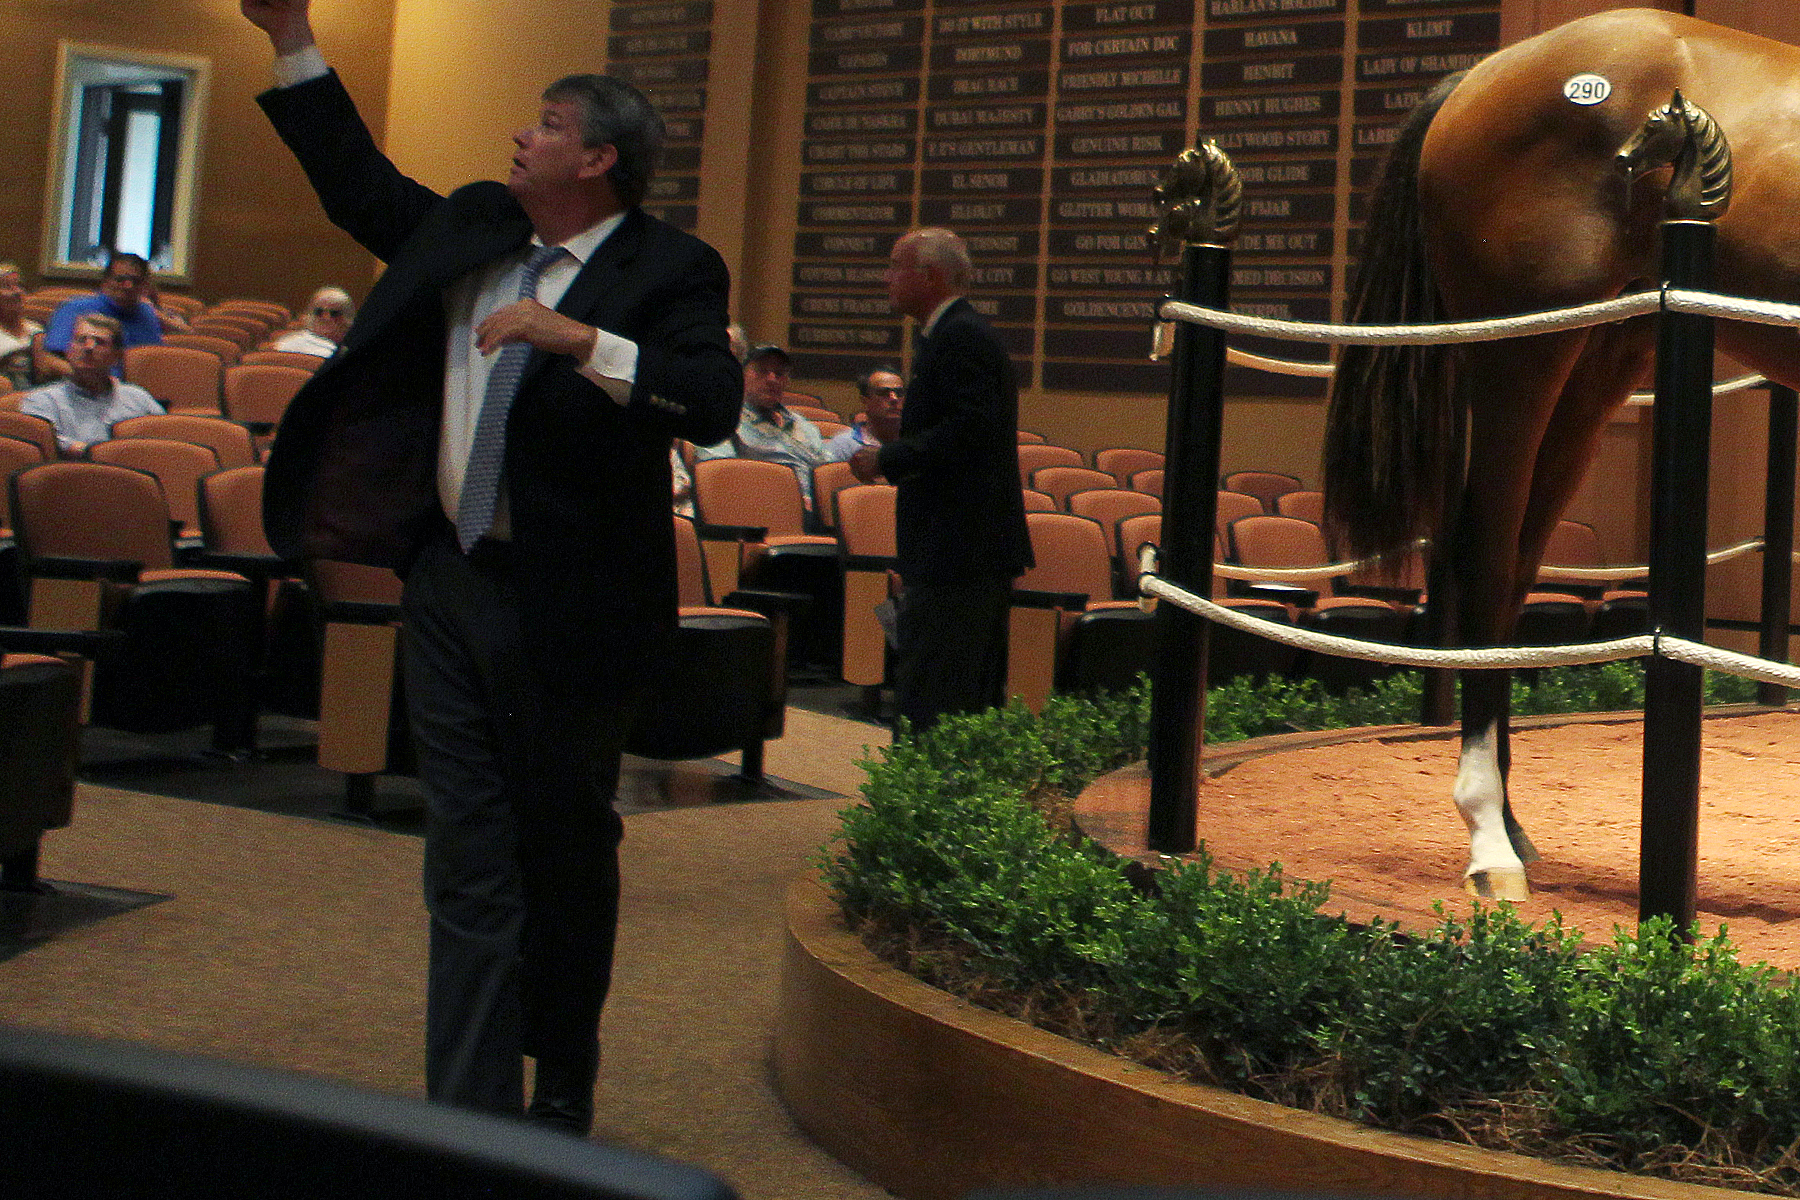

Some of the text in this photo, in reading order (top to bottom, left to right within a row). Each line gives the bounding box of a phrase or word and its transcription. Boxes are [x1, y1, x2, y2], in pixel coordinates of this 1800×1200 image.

[1004, 12, 1043, 29] STYLE
[1095, 3, 1157, 23] FLAT OUT
[1244, 28, 1298, 48] HAVANA
[1405, 19, 1455, 39] KLIMT
[1068, 40, 1093, 58] FOR
[1094, 36, 1150, 56] CERTAIN
[1242, 61, 1296, 81] HENBIT
[1361, 58, 1397, 76] LADY
[1399, 57, 1417, 73] OF
[1570, 81, 1606, 99] 290
[1106, 102, 1154, 120] GOLDEN
[1156, 100, 1182, 118] GAL
[1215, 95, 1322, 116] HENNY HUGHES
[1071, 135, 1164, 153] GENUINE RISK
[1203, 128, 1331, 149] LLYWOOD STORY
[1266, 164, 1310, 182] GLIDE
[1059, 201, 1160, 218] GLITTER WOMA
[1075, 234, 1149, 250] GO FOR GIN
[1265, 234, 1286, 250] ME
[1288, 233, 1318, 250] OUT
[1050, 267, 1069, 284] GO
[1264, 269, 1325, 286] DECISION
[1063, 301, 1155, 318] GOLDENCENTS
